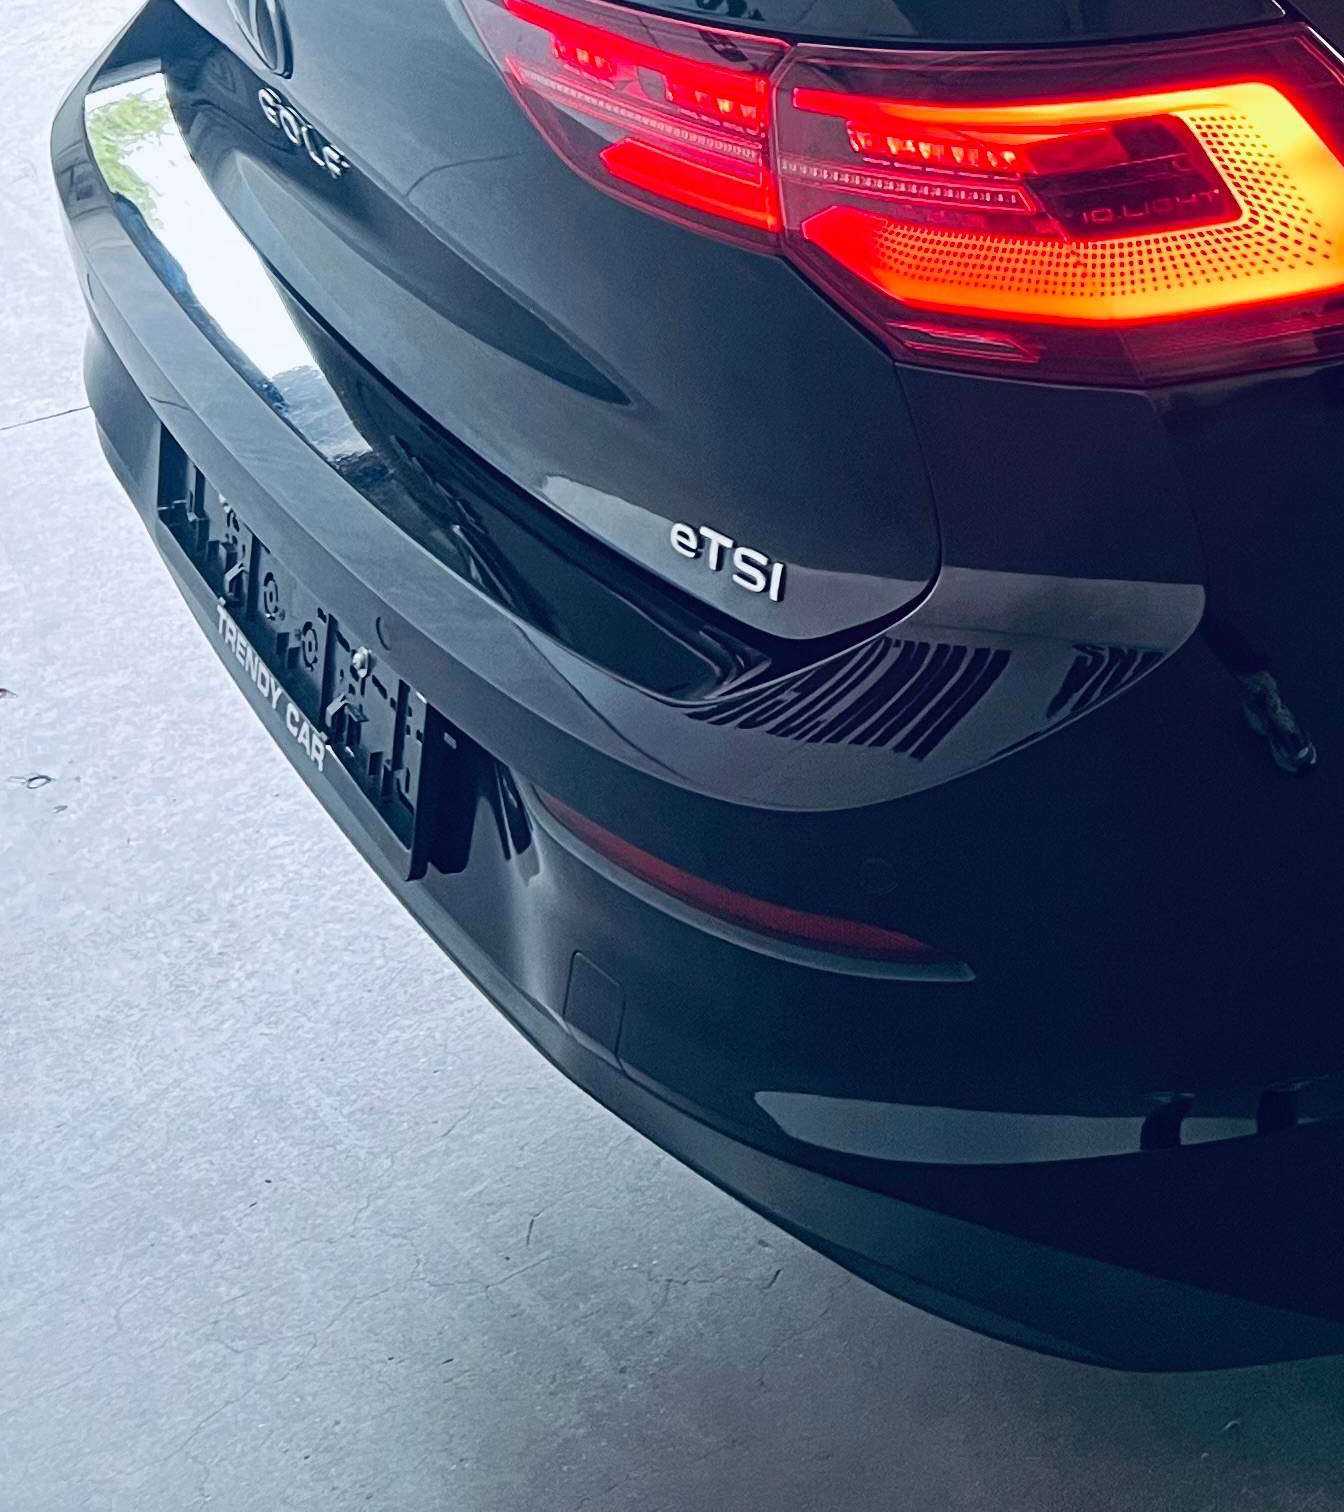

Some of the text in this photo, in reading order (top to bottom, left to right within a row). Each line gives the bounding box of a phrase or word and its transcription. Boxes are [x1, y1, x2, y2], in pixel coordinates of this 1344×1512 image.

[258, 87, 350, 179] GOLF
[670, 522, 784, 602] eTSI
[216, 597, 328, 772] TRENDY CAR
